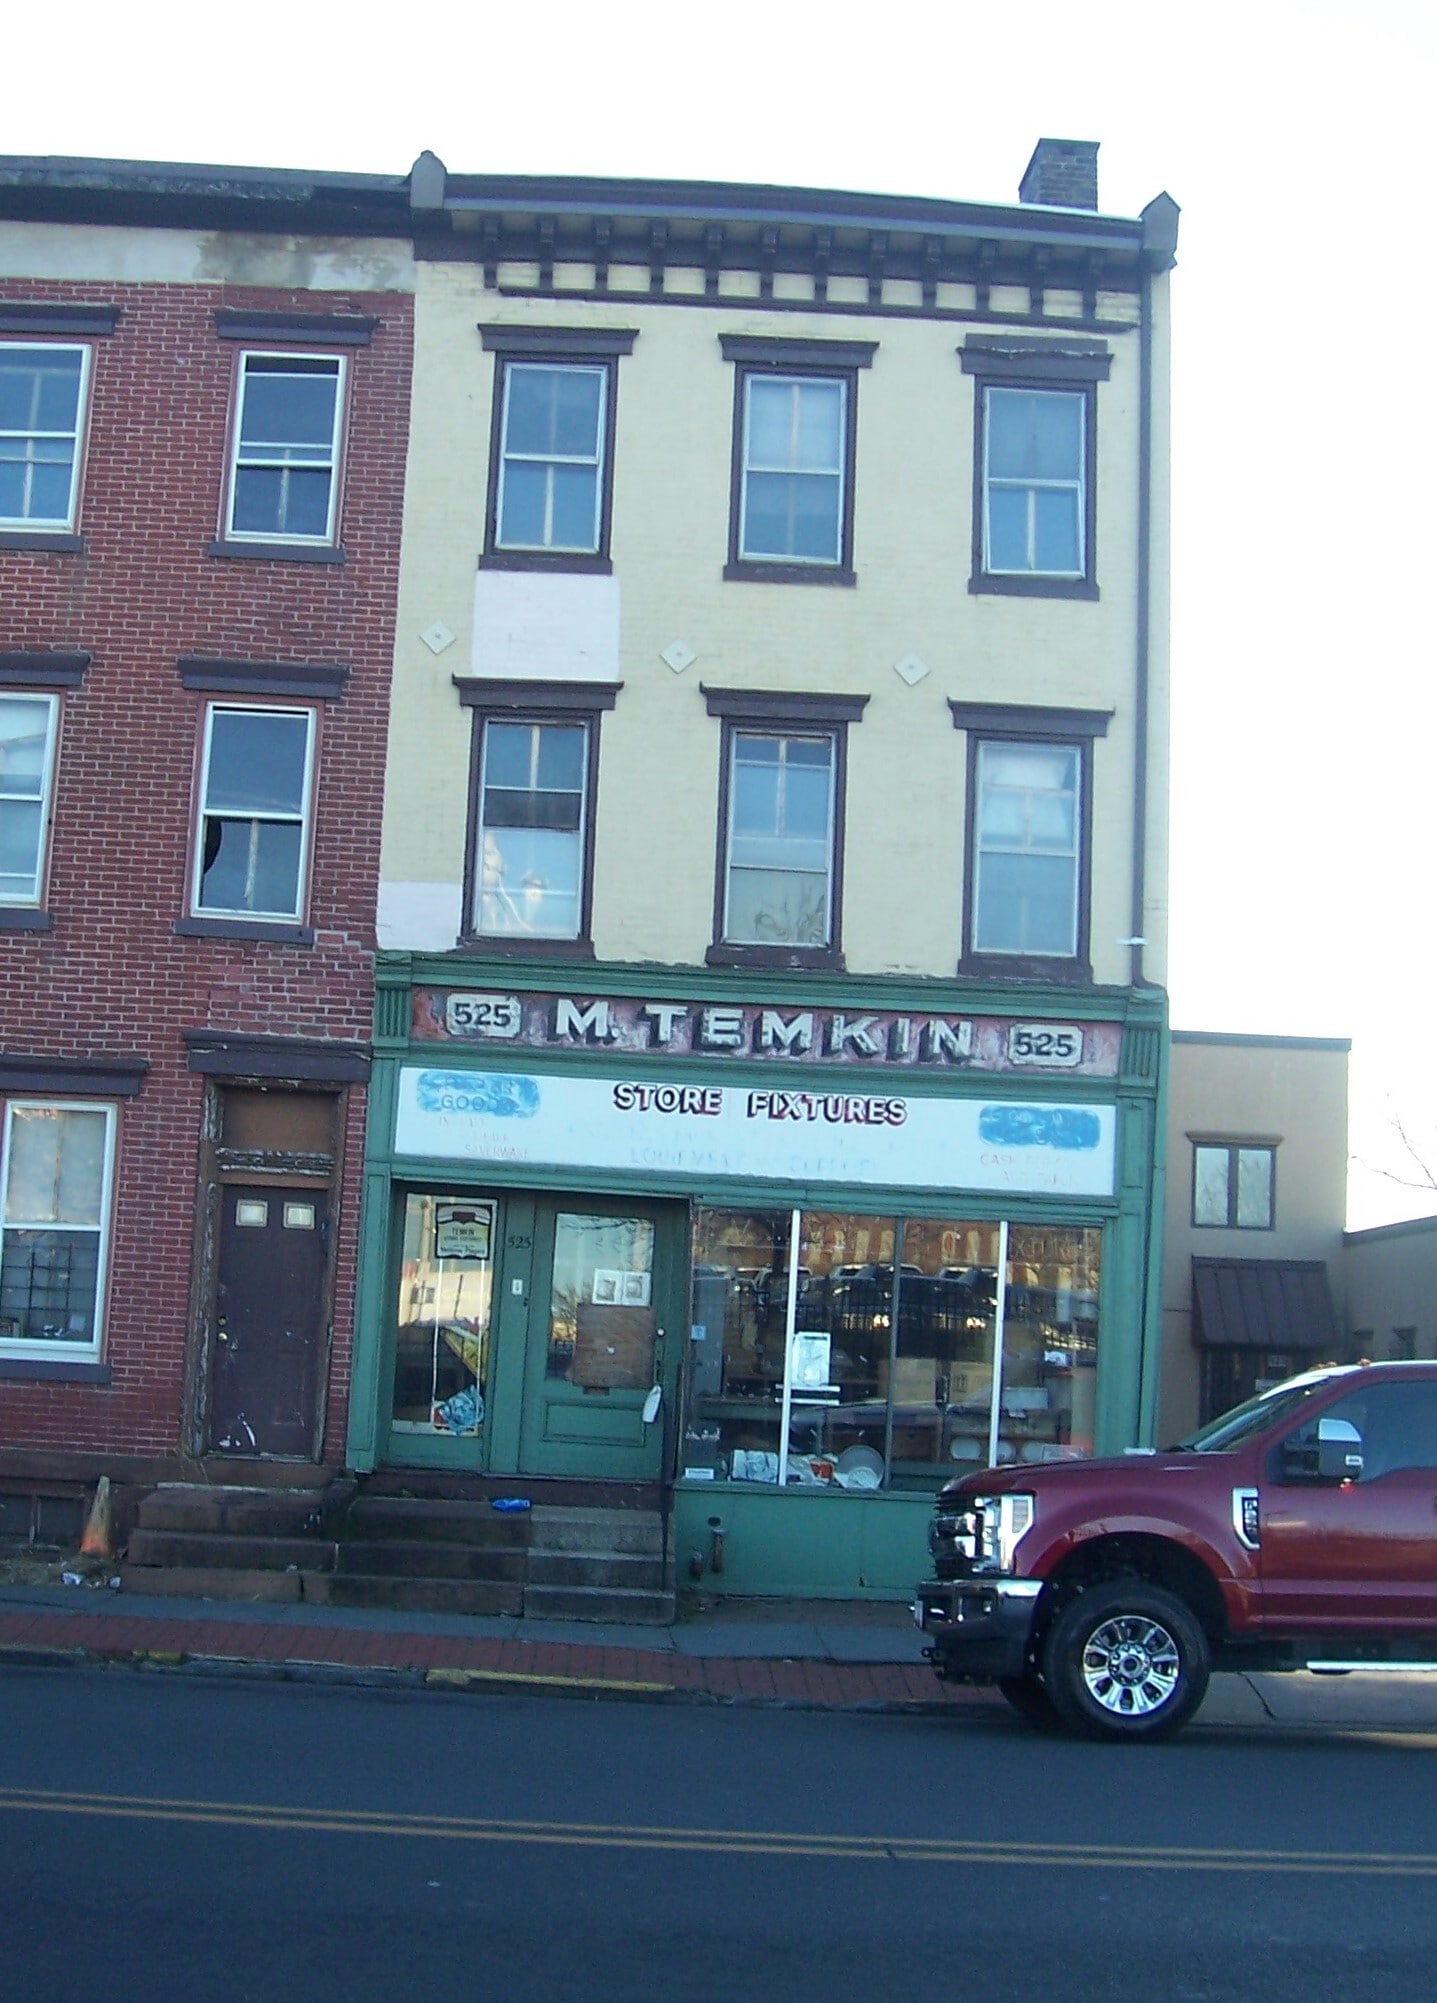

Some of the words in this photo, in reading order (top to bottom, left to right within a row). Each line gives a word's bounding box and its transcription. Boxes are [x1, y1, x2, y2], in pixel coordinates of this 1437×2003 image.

[453, 1002, 511, 1027] 525
[548, 999, 620, 1044] M.
[643, 1003, 974, 1065] TEMKIN
[1013, 1032, 1074, 1058] 525
[612, 1082, 722, 1116] STORE
[746, 1090, 907, 1126] FIXTURES
[507, 1234, 532, 1249] 525
